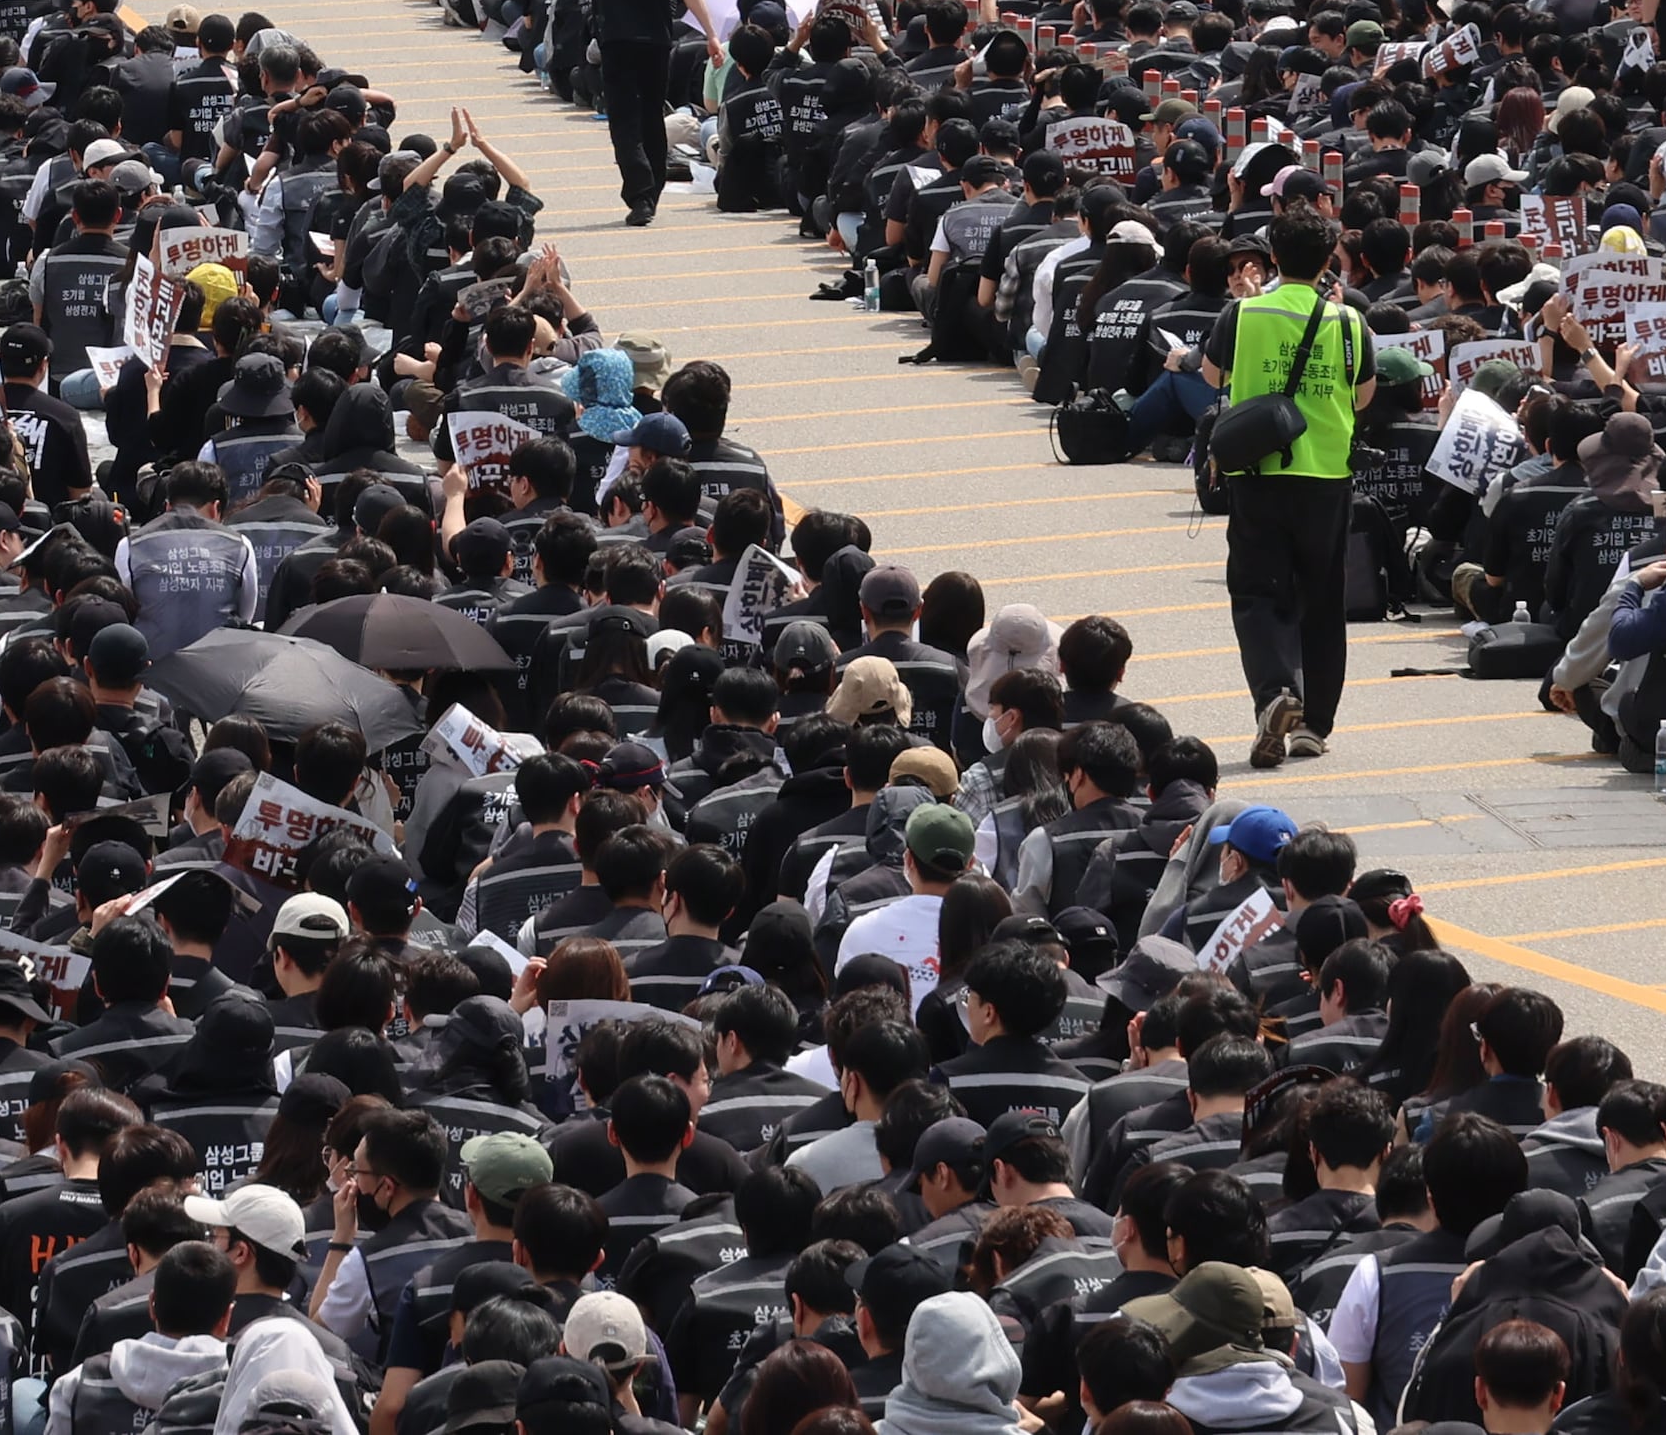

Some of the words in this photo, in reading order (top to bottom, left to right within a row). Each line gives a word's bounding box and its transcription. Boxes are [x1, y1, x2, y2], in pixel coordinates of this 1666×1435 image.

[790, 106, 810, 119] 초기업
[745, 114, 768, 128] 초기업
[1053, 124, 1126, 149] 투명하게
[166, 234, 238, 266] 투명하게
[62, 290, 85, 301] 초기업
[65, 305, 97, 317] 삼성전자
[1312, 383, 1334, 399] 지부
[499, 403, 538, 416] 삼성그룹
[1403, 482, 1422, 496] 지부
[1611, 515, 1654, 530] 삼성그룹
[1593, 532, 1624, 547] 초기업
[168, 547, 209, 559] 삼성그룹
[158, 576, 200, 592] 삼성전자
[206, 577, 226, 592] 지부
[205, 1142, 264, 1166] 삼성그룹
